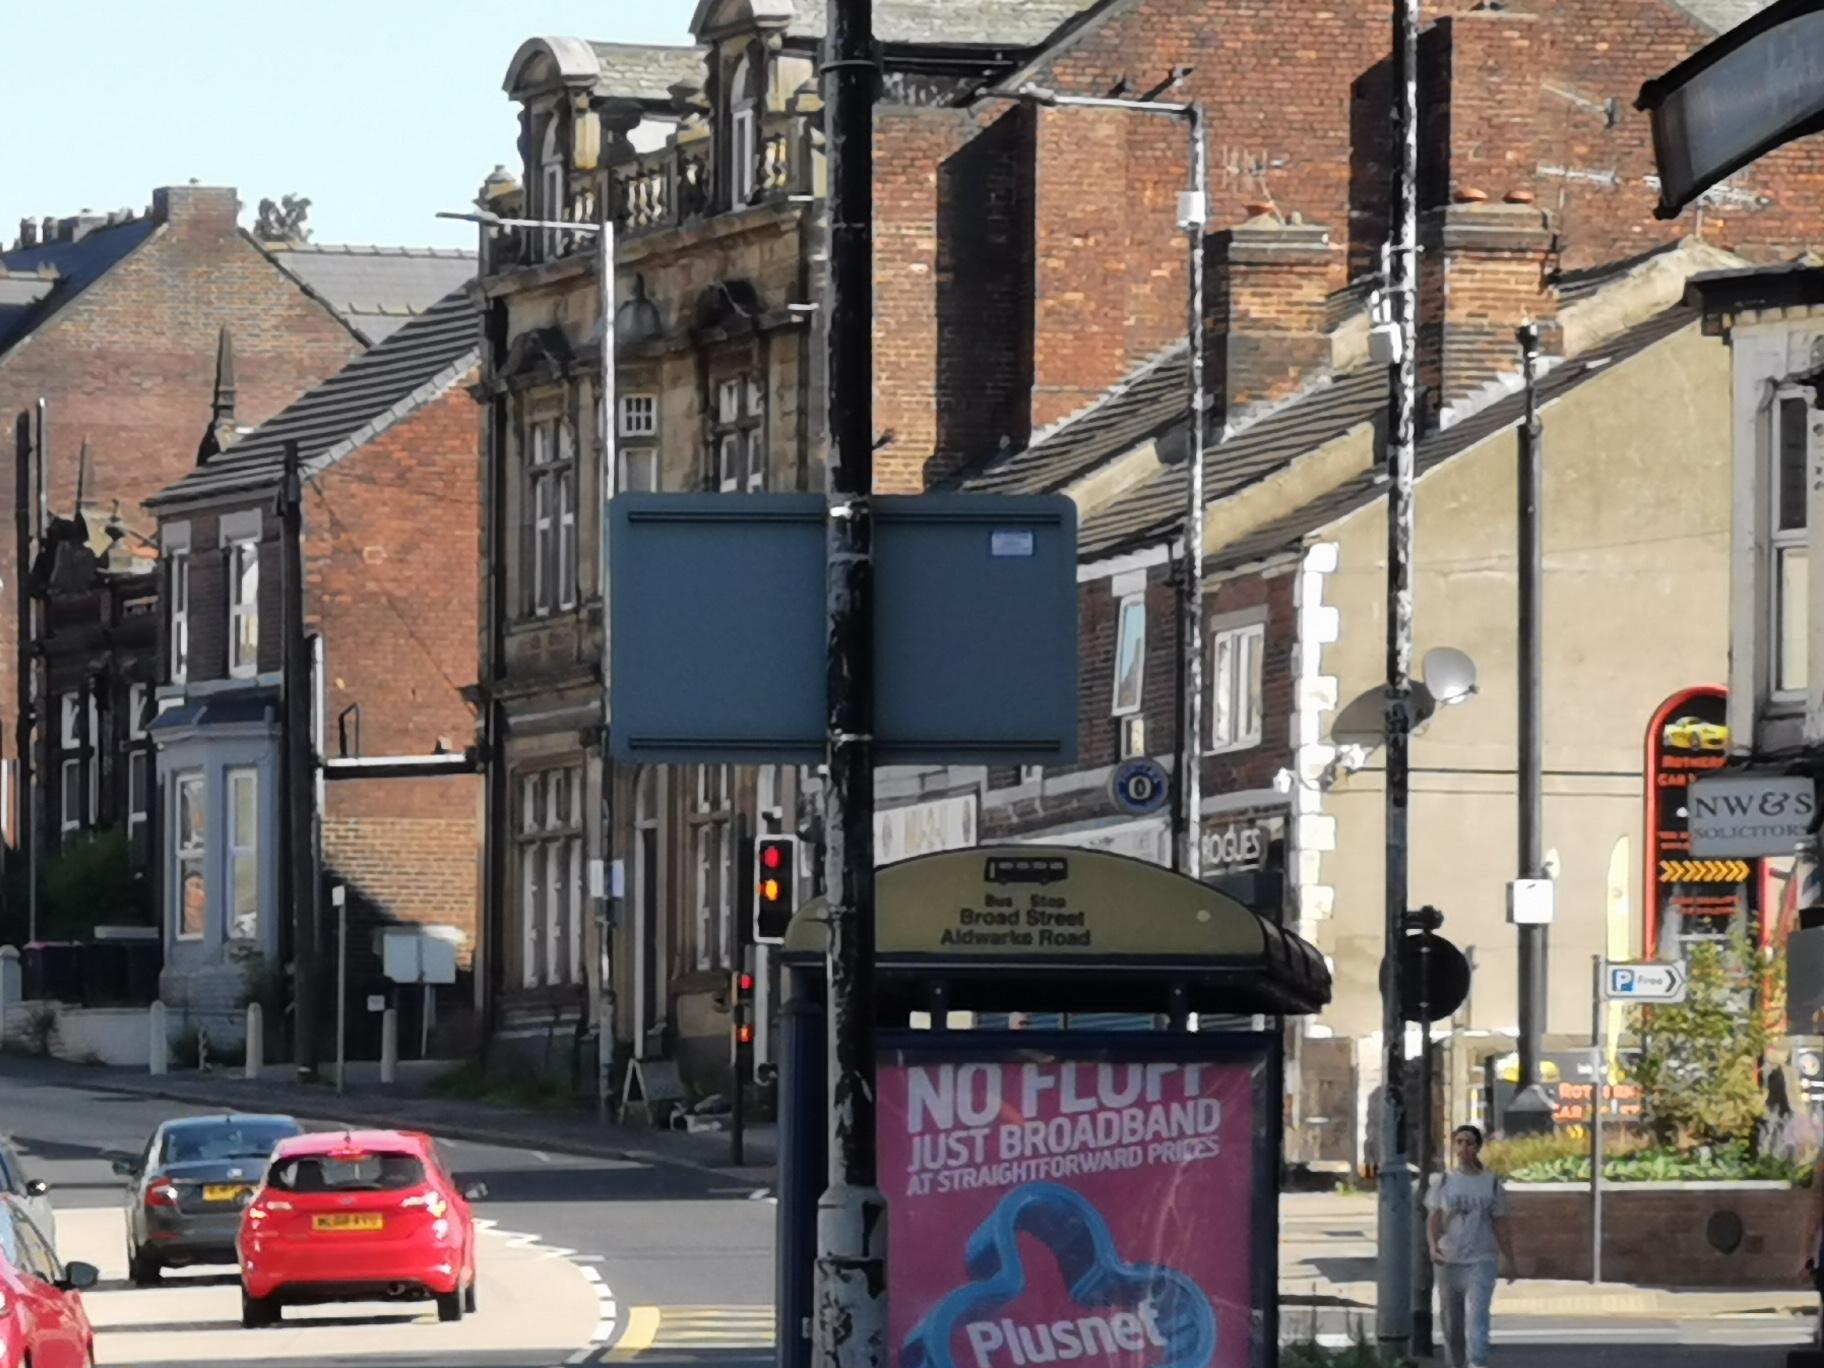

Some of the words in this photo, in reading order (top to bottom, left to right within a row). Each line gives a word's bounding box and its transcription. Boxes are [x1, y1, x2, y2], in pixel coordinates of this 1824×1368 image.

[940, 928, 1034, 945] Aldwarke
[1039, 929, 1091, 946] Road
[960, 908, 1020, 926] Broad
[1026, 909, 1085, 926] Street
[907, 1063, 1003, 1134] NO
[906, 1172, 935, 1197] AT
[937, 1145, 1143, 1193] STRAIGHTFORWARD
[1147, 1134, 1221, 1165] PRICES
[907, 1127, 991, 1174] JUST
[999, 1098, 1222, 1160] BROADBAND
